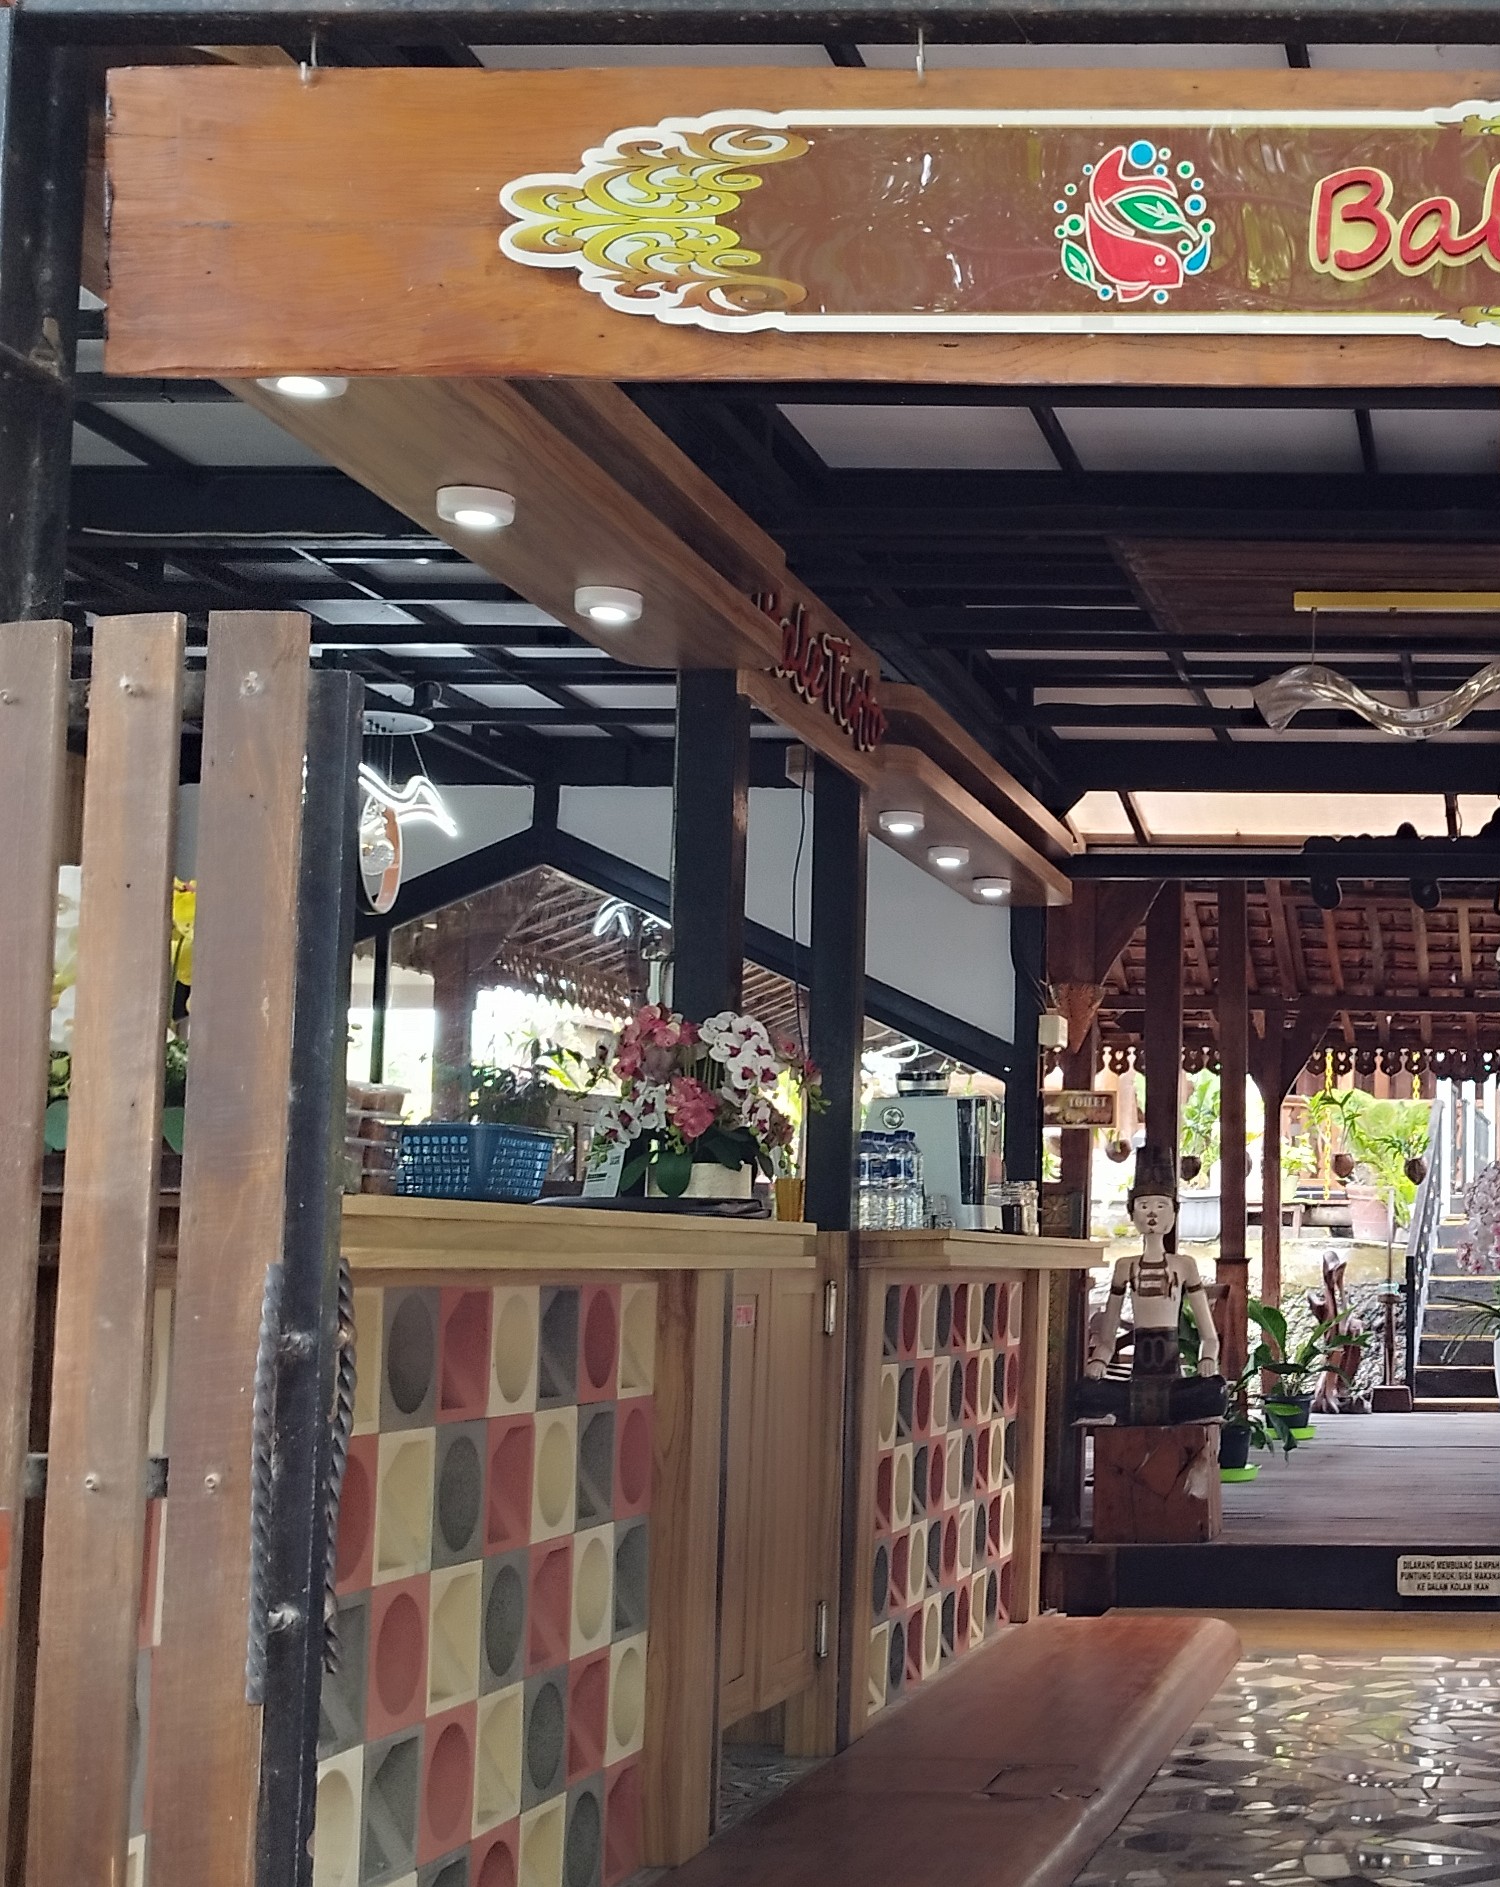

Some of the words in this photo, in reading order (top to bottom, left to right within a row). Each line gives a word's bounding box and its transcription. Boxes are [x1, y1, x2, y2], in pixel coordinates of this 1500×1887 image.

[1069, 1096, 1107, 1107] TOILET
[1403, 1561, 1435, 1570] DILARANG
[1437, 1561, 1473, 1570] MEMBUANG
[1401, 1571, 1431, 1580] PUNTUNG
[1416, 1583, 1426, 1591] KE
[1427, 1583, 1448, 1591] DALAM
[1450, 1583, 1472, 1591] KOLAM
[1474, 1583, 1490, 1591] IKAN
